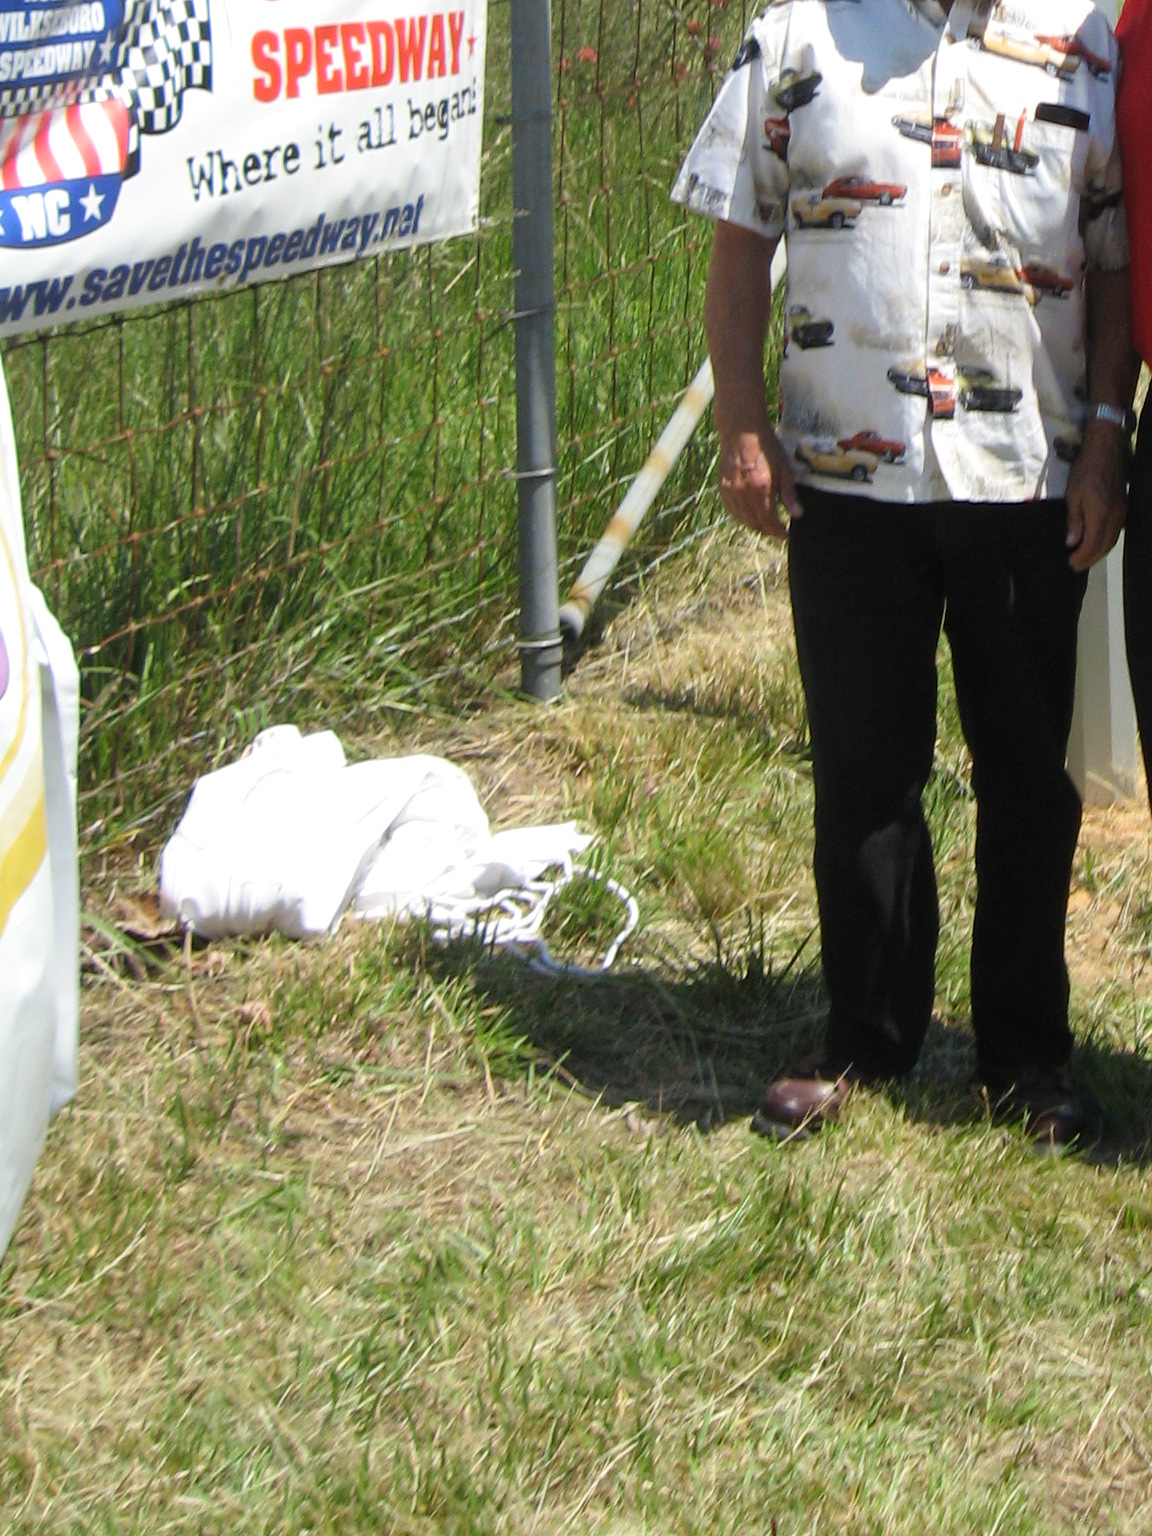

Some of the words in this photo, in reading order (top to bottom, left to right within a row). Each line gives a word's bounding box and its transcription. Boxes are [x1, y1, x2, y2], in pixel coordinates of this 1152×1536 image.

[251, 11, 465, 103] SPEEDWAY
[187, 141, 300, 202] Where
[314, 121, 344, 170] it
[357, 104, 396, 153] all
[407, 75, 477, 141] began!
[10, 188, 71, 241] NC
